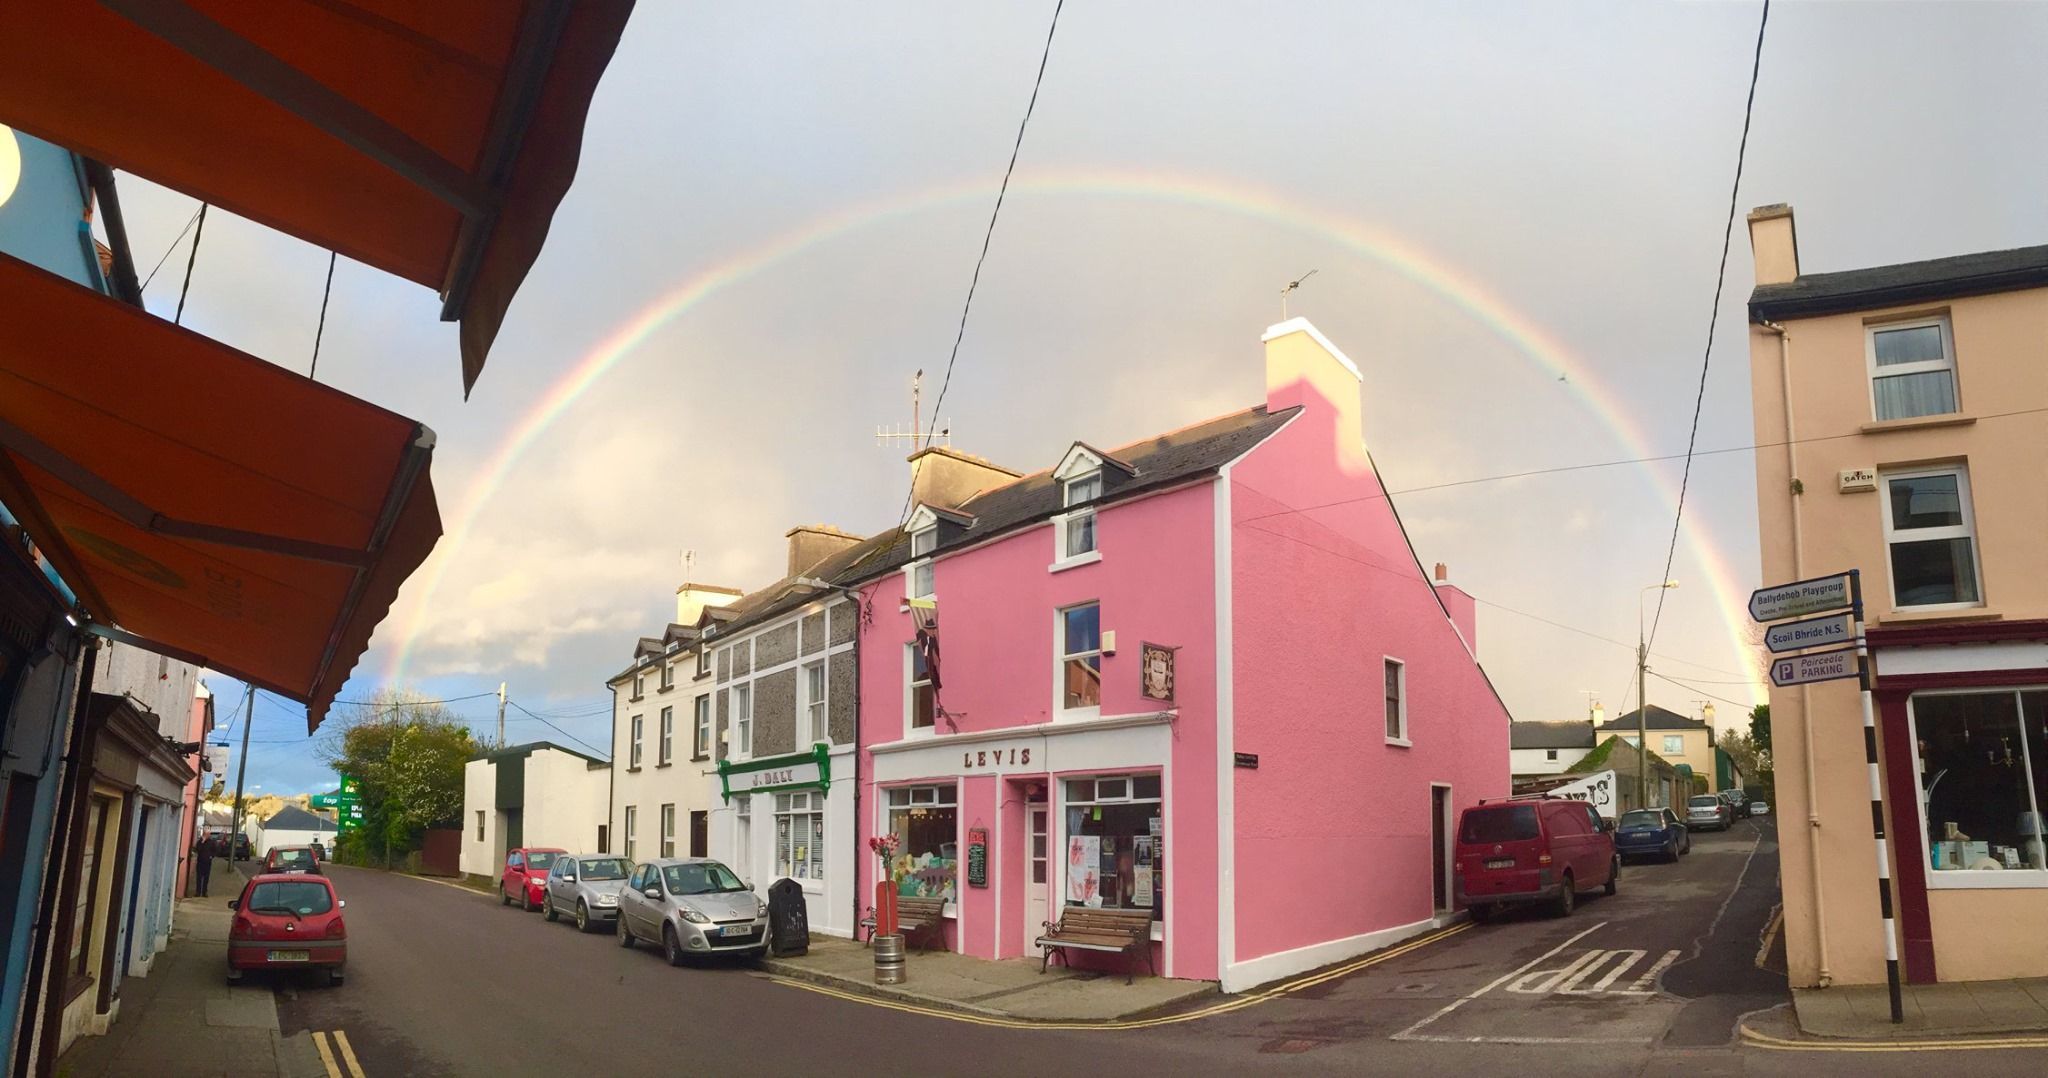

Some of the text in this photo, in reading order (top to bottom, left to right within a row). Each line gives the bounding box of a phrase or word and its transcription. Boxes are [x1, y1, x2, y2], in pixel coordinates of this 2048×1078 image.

[1844, 474, 1873, 482] CATCH
[1757, 590, 1800, 605] Ballydehob
[1802, 582, 1844, 597] Playgroup
[1772, 632, 1793, 643] Scoil
[1825, 624, 1844, 635] N.S.
[1782, 665, 1791, 679] P
[1801, 664, 1843, 677] PARKING
[964, 748, 1030, 768] LEVIS
[764, 770, 793, 784] DALY
[323, 797, 338, 805] top
